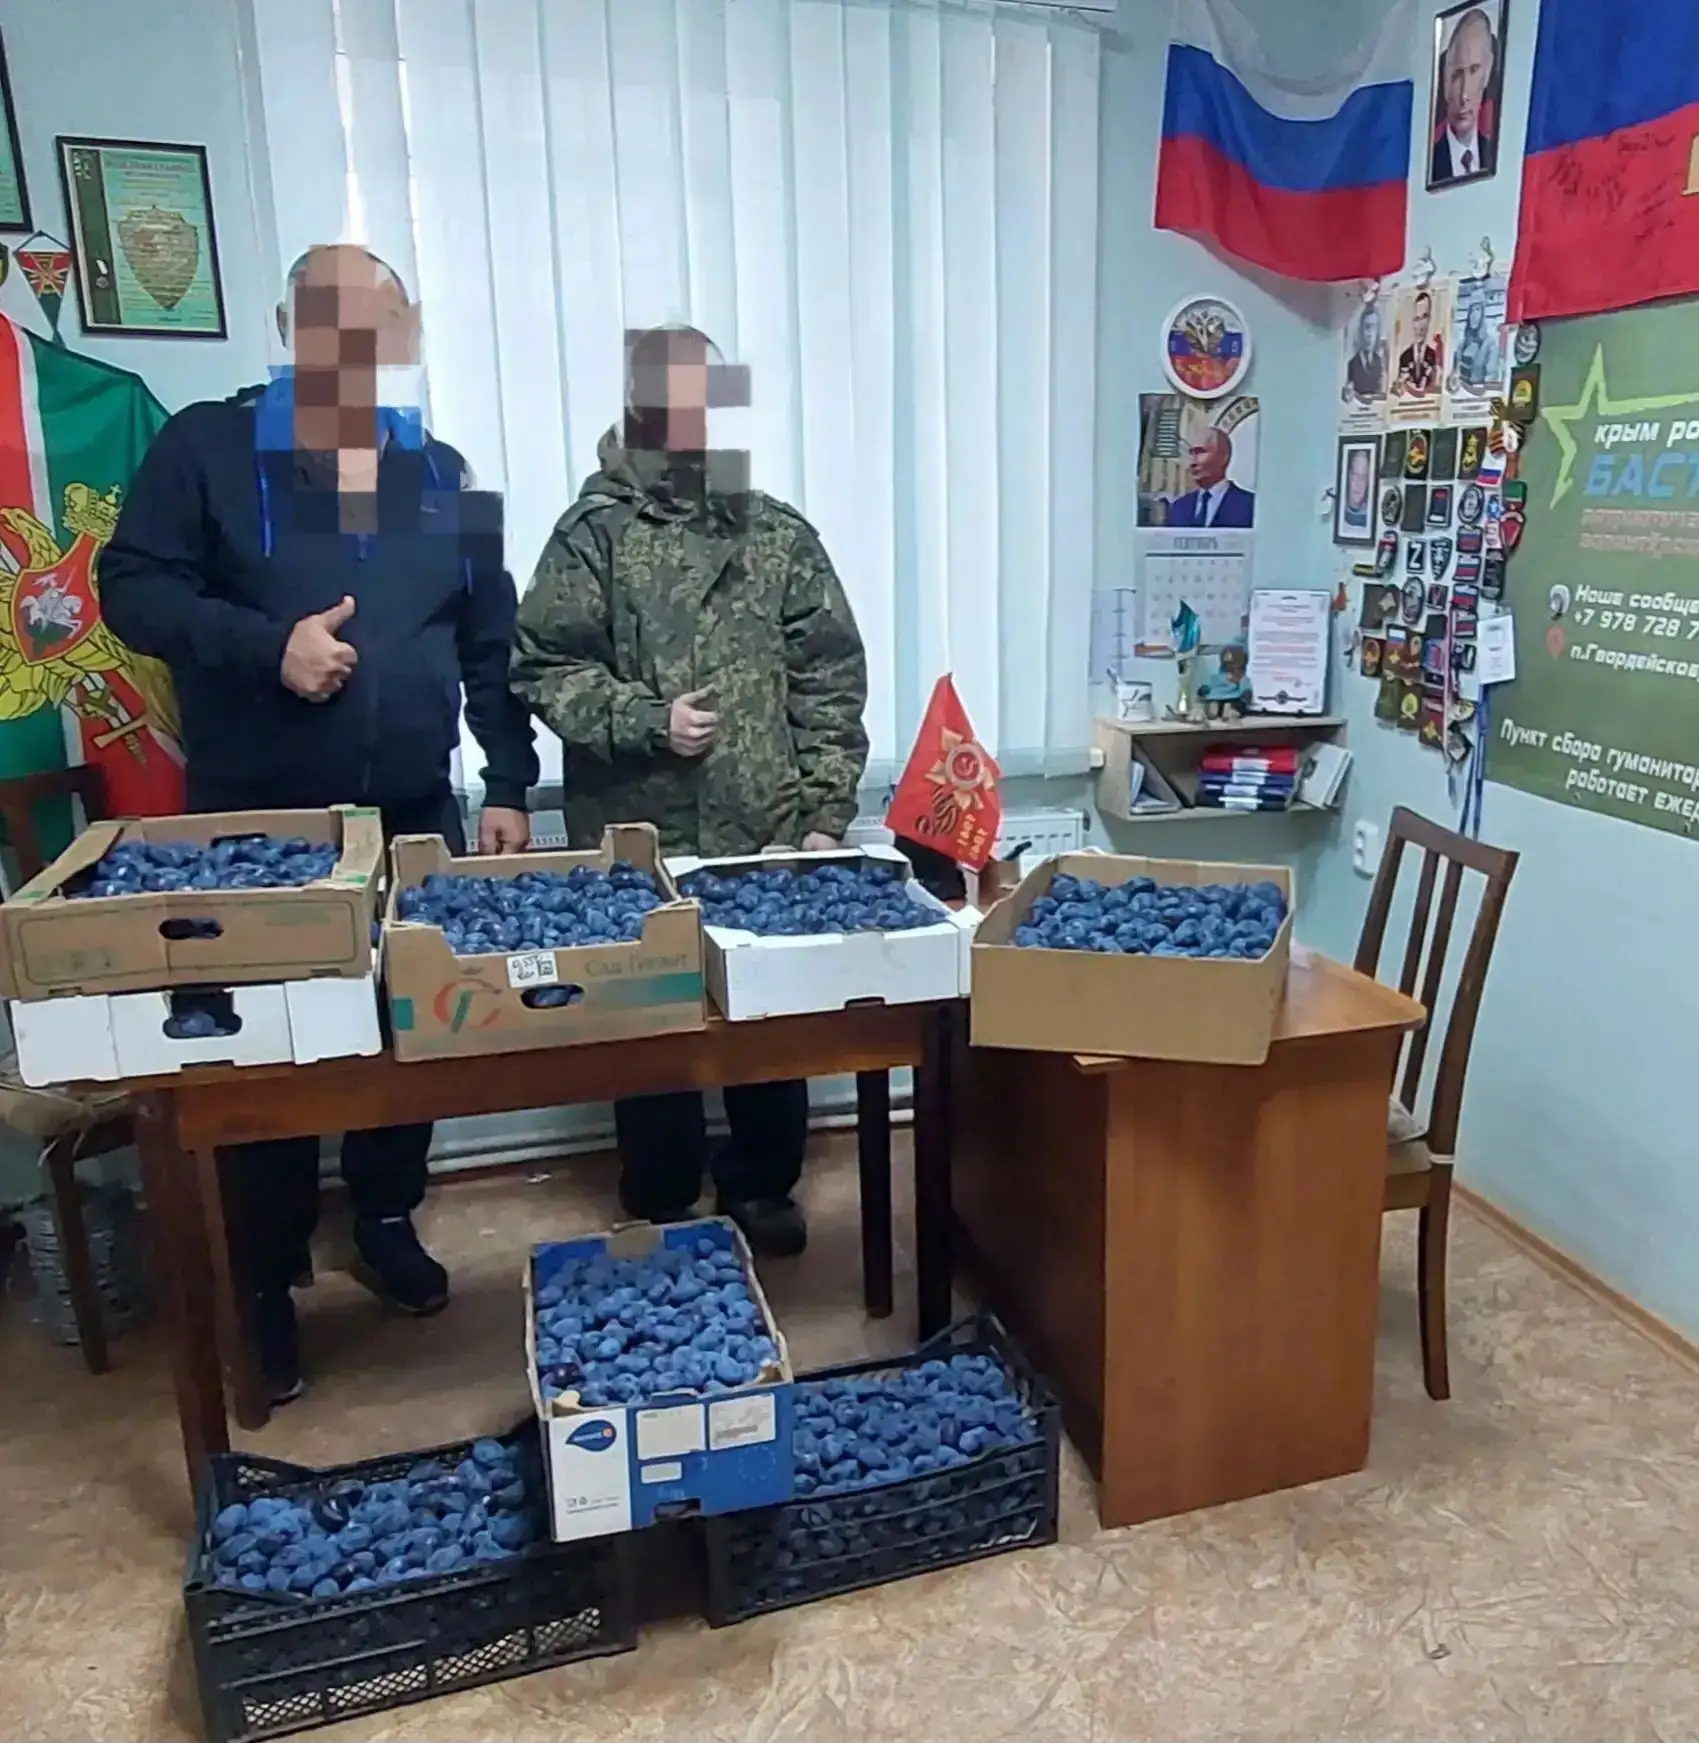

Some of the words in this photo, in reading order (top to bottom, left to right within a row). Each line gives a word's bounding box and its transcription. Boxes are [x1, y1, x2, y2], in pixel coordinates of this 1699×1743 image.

[1594, 422, 1660, 449] крым
[1575, 584, 1624, 606] Наше
[1574, 608, 1596, 626] +7
[1600, 611, 1637, 632] 978
[1642, 615, 1681, 637] 728
[1686, 620, 1699, 640] 7
[1500, 718, 1548, 747] Пункт
[1552, 731, 1602, 763] сбора
[1565, 768, 1649, 805] работает
